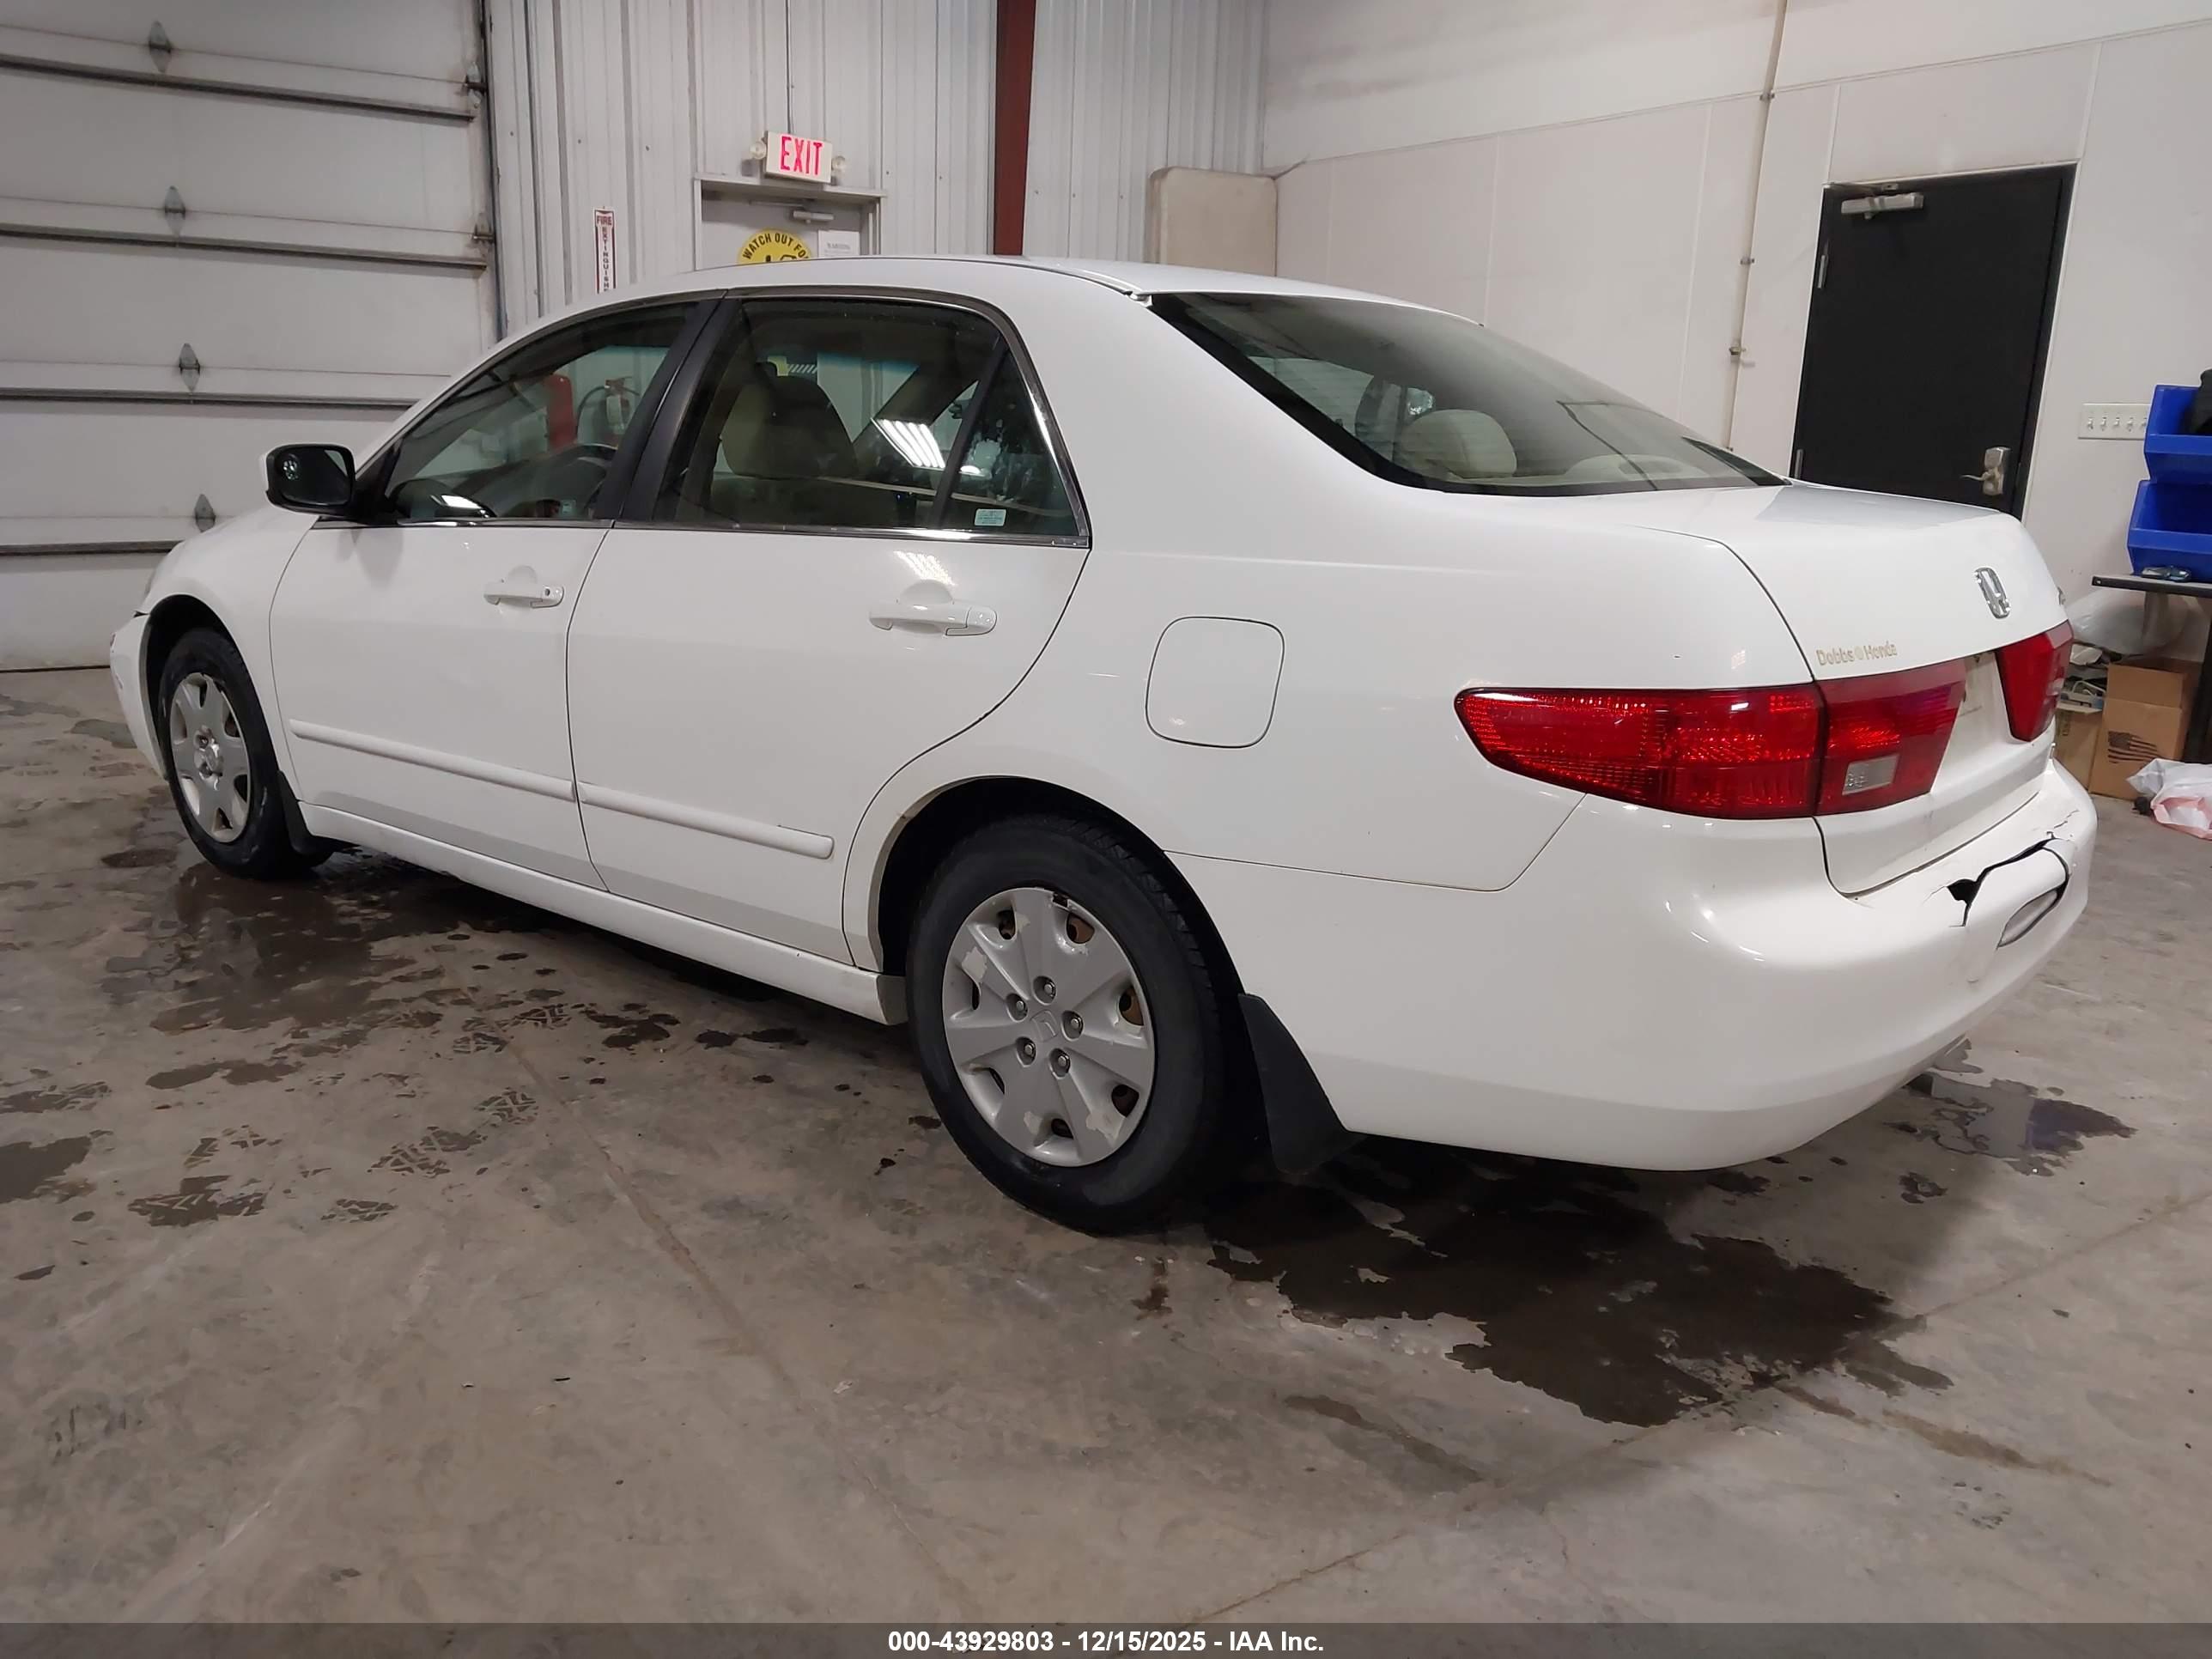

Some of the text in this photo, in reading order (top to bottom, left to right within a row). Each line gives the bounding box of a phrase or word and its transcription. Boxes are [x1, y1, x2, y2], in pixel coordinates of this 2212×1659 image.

[781, 136, 823, 175] EXIT
[597, 216, 612, 225] FIRE
[743, 233, 772, 259] WATCH
[775, 232, 794, 247] OUT
[793, 244, 809, 259] FO
[1816, 647, 1855, 665] Dobbs
